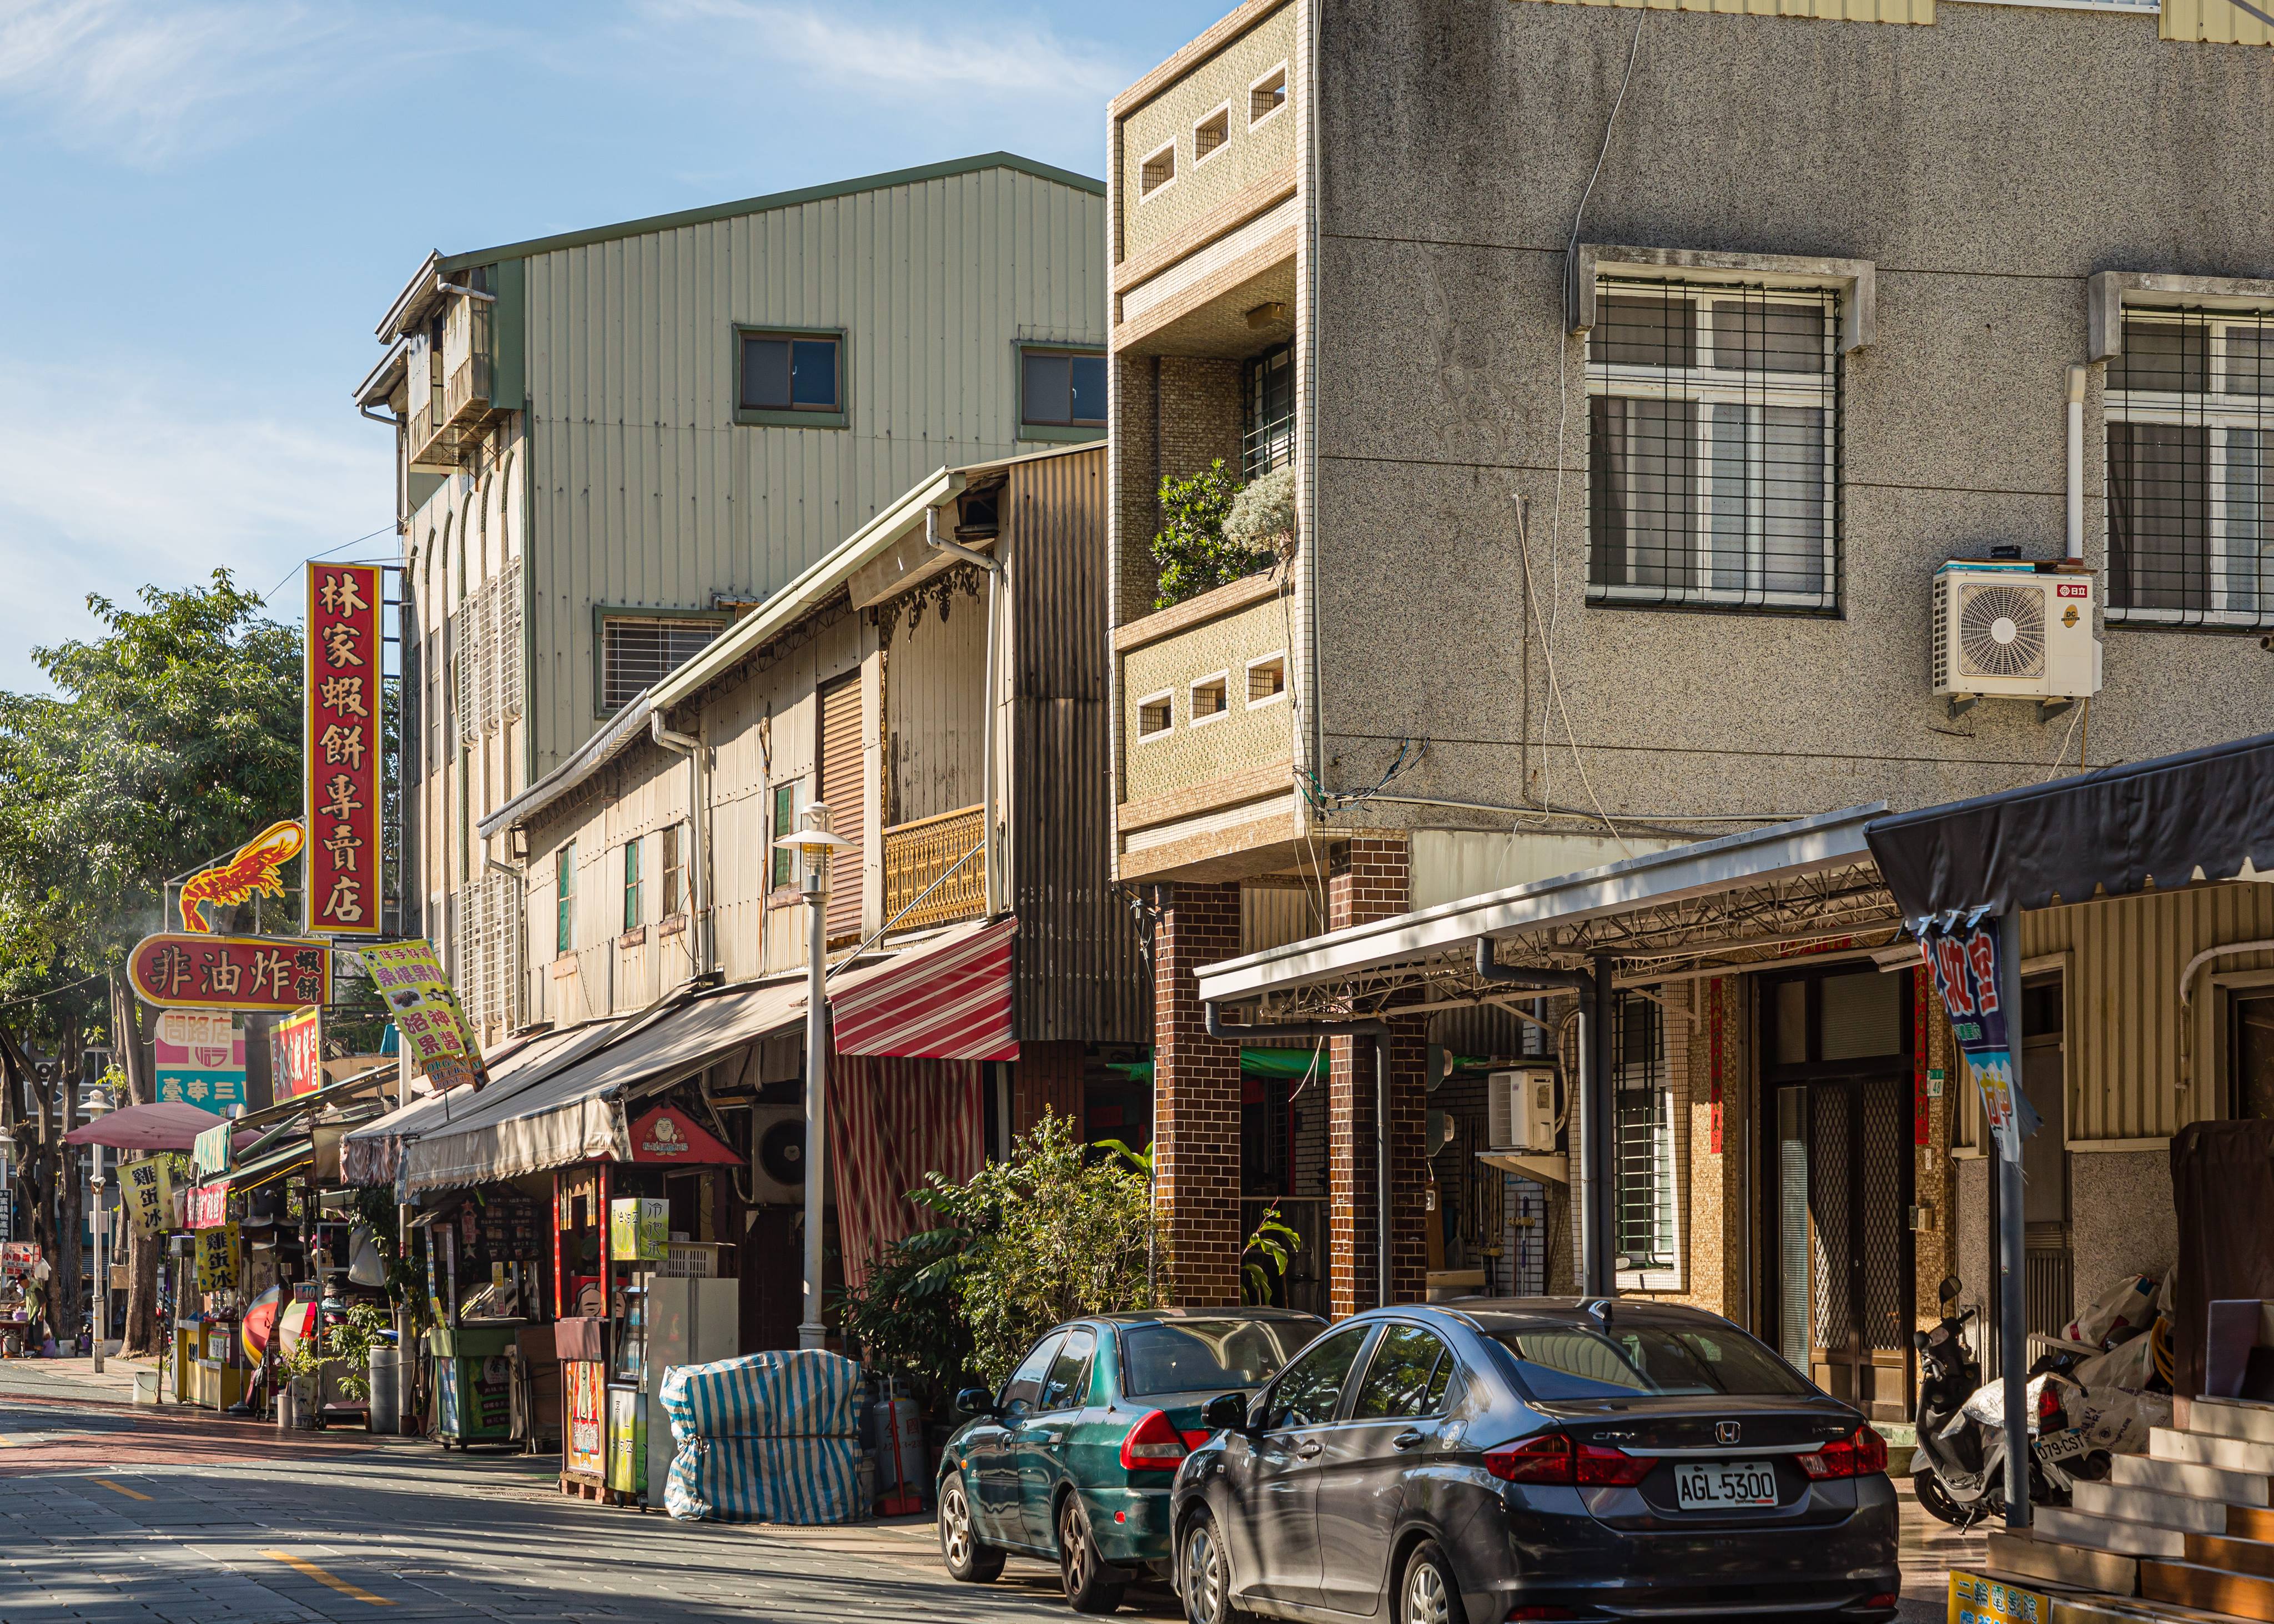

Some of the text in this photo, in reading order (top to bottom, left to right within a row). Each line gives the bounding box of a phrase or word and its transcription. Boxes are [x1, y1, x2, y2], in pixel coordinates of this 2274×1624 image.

[319, 571, 369, 924] 林家蝦餅專賣店
[149, 946, 293, 1002] 非油炸
[294, 949, 321, 1003] 蝦餅
[417, 1030, 462, 1056] 果醬
[1933, 1082, 1941, 1094] 48
[132, 1165, 163, 1229] 雞蛋冰
[647, 1202, 663, 1256] 冷泡茶
[206, 1231, 234, 1289] 雞蛋冰
[2037, 1434, 2085, 1460] 079-CST
[1681, 1472, 1775, 1501] AGL-5300
[1956, 1580, 2038, 1623] 二輪電影院
